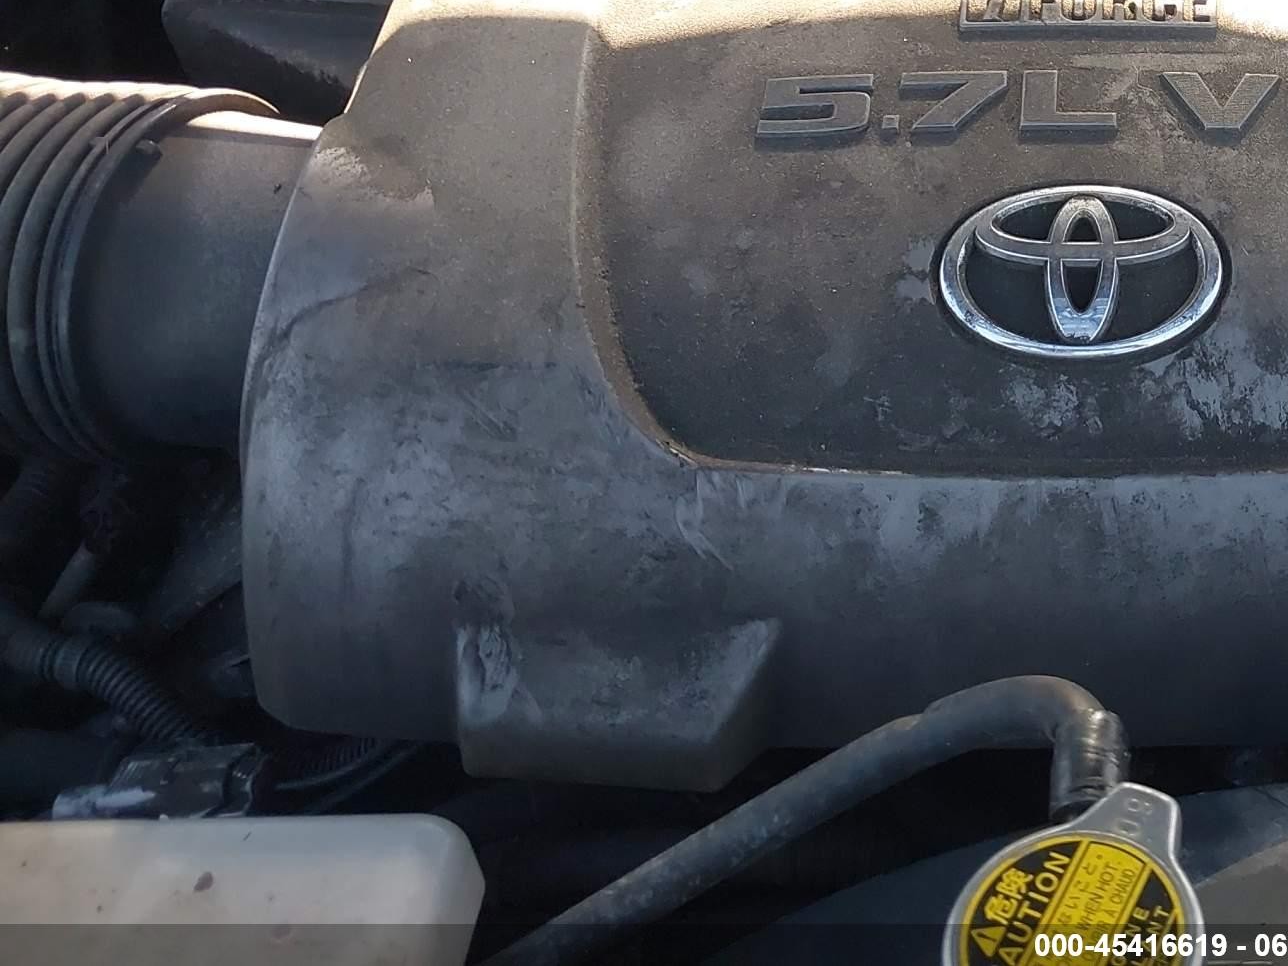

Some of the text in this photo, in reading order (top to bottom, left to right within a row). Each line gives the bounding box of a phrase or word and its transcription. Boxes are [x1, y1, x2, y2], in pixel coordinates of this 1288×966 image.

[756, 70, 1118, 138] 5.7L
[984, 868, 1034, 926] 危険
[993, 851, 1071, 966] AUTION
